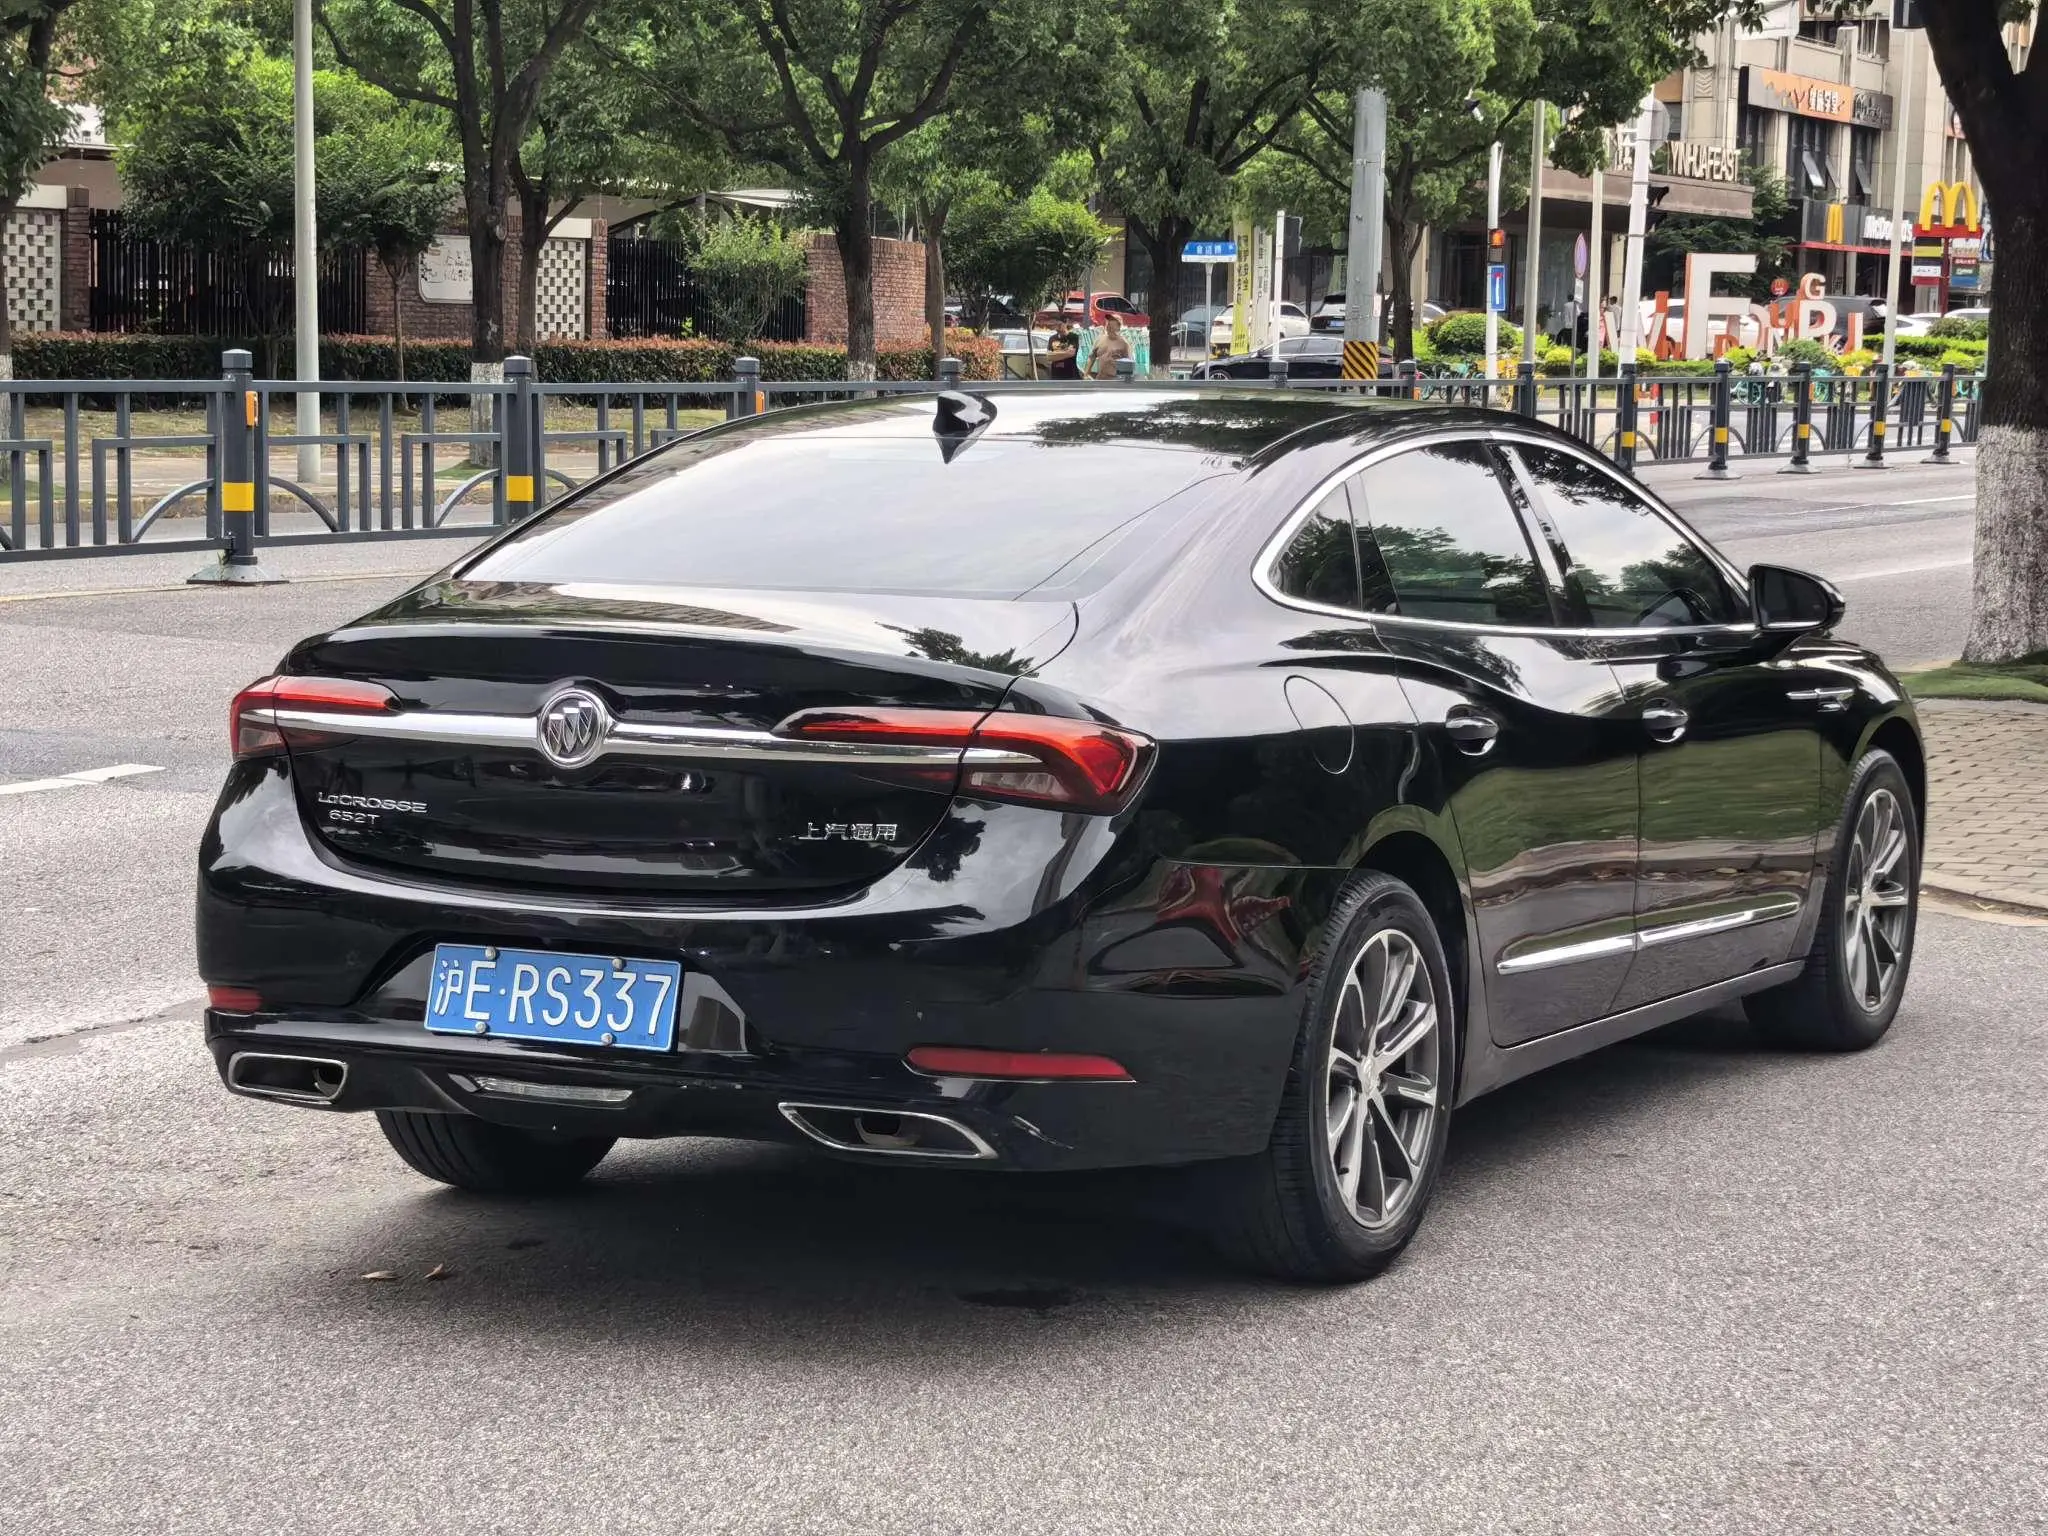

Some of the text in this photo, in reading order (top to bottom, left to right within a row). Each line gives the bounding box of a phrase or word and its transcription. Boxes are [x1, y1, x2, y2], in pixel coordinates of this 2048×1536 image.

[329, 809, 381, 825] 652T
[798, 822, 898, 841] 上汽通用
